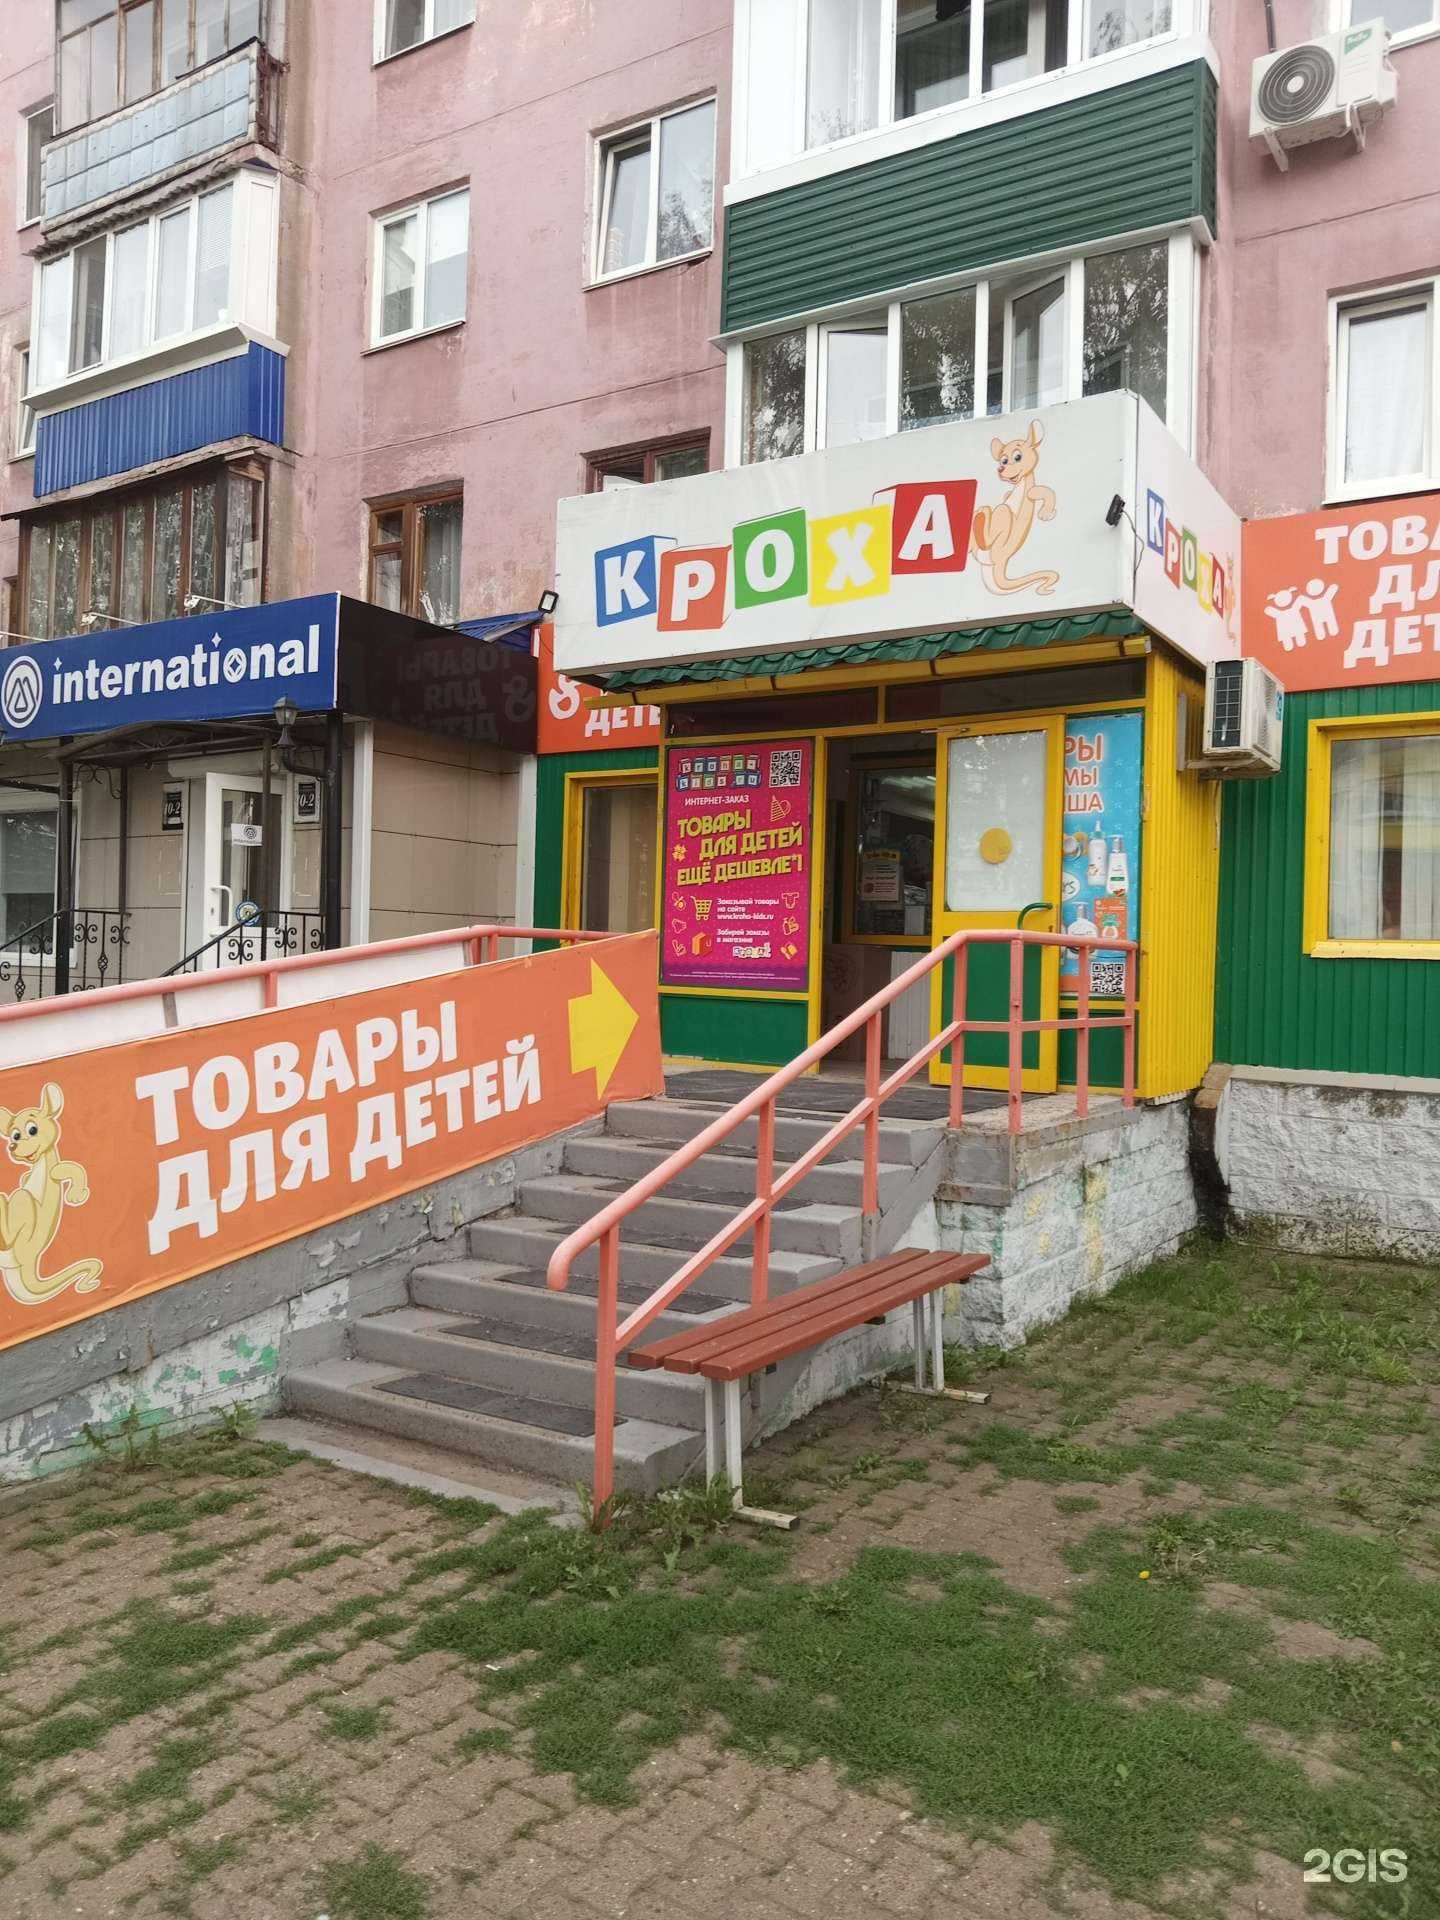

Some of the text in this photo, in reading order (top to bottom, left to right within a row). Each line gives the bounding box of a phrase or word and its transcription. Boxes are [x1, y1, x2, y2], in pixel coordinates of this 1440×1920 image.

[603, 494, 954, 622] КРОХА
[1149, 497, 1223, 609] КРОХА
[53, 624, 320, 704] international
[678, 809, 751, 838] ТОВАРЫ
[685, 795, 749, 806] ИНТЕРНЕТ-ЗАКАЗ
[700, 821, 802, 860] ДЛЯ ДЕТЕЙ
[677, 862, 711, 885] ЕЩЁ
[135, 1001, 457, 1145] ТОВАРЫ
[148, 1034, 541, 1255] ДЛЯ ДЕТЕЙ
